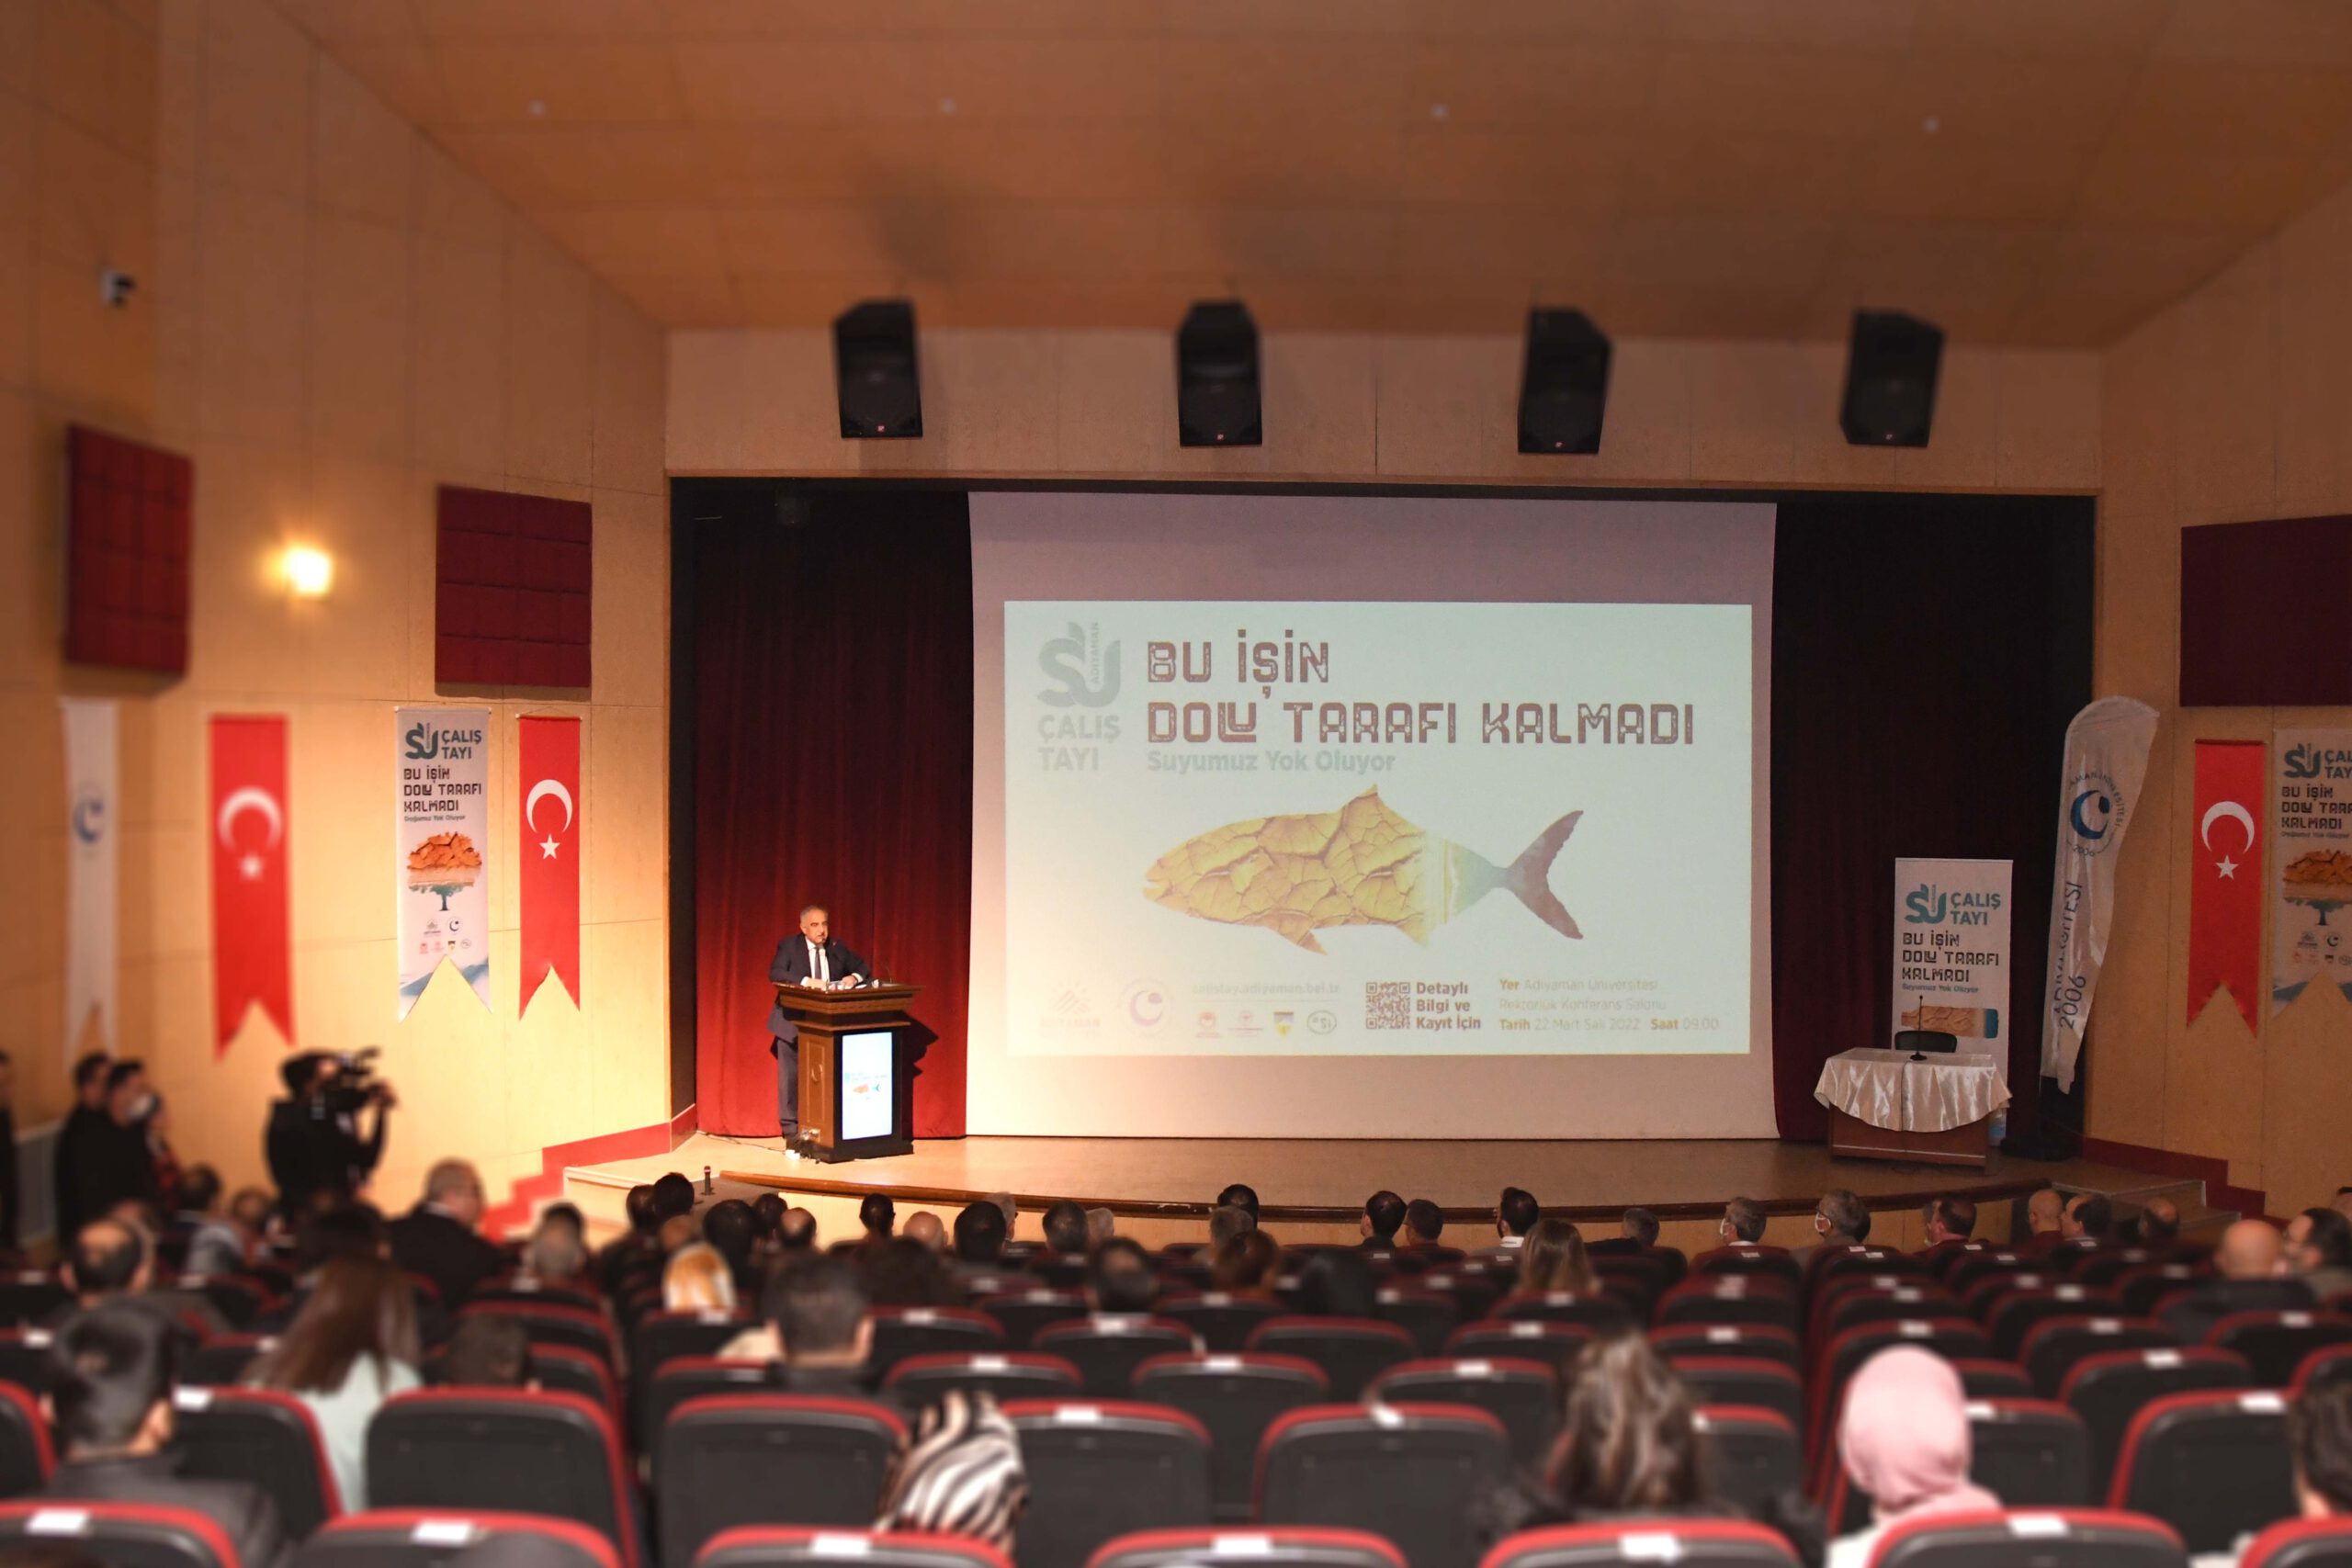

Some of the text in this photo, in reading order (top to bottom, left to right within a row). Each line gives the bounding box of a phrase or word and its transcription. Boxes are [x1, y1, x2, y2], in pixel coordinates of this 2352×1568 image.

[1148, 628, 1329, 699] BU İŞİN
[1037, 715, 1121, 743] ÇALIŞ
[1148, 702, 1693, 744] DOLU TARAFI KALMADI
[442, 729, 482, 744] ÇALIŞ
[441, 747, 472, 760] TAYI
[1038, 747, 1100, 772] TAYI
[2324, 750, 2352, 764] ÇAL
[1148, 750, 1396, 774] Suyumuz Yok Oluyor
[403, 768, 421, 780] BU
[2324, 766, 2352, 779] TAY
[439, 784, 481, 795] TARAFI
[2281, 786, 2301, 797] BU
[403, 800, 459, 812] KALMADI
[2281, 817, 2342, 829] KALMADI
[1951, 892, 2001, 909] ÇALIŞ
[1951, 910, 1988, 926] TAYI
[1903, 932, 1924, 945] BU
[1944, 952, 1999, 965] TARAFI
[1902, 967, 1970, 982] KALMADI
[1416, 981, 1469, 997] Detaylı
[1499, 979, 1520, 991] Yer
[1416, 998, 1471, 1014] Bilgi ve
[2058, 975, 2086, 1030] 2006
[1416, 1017, 1453, 1032] Kayıt
[1499, 1018, 1531, 1031] Tarih
[1650, 1018, 1679, 1031] Saat
